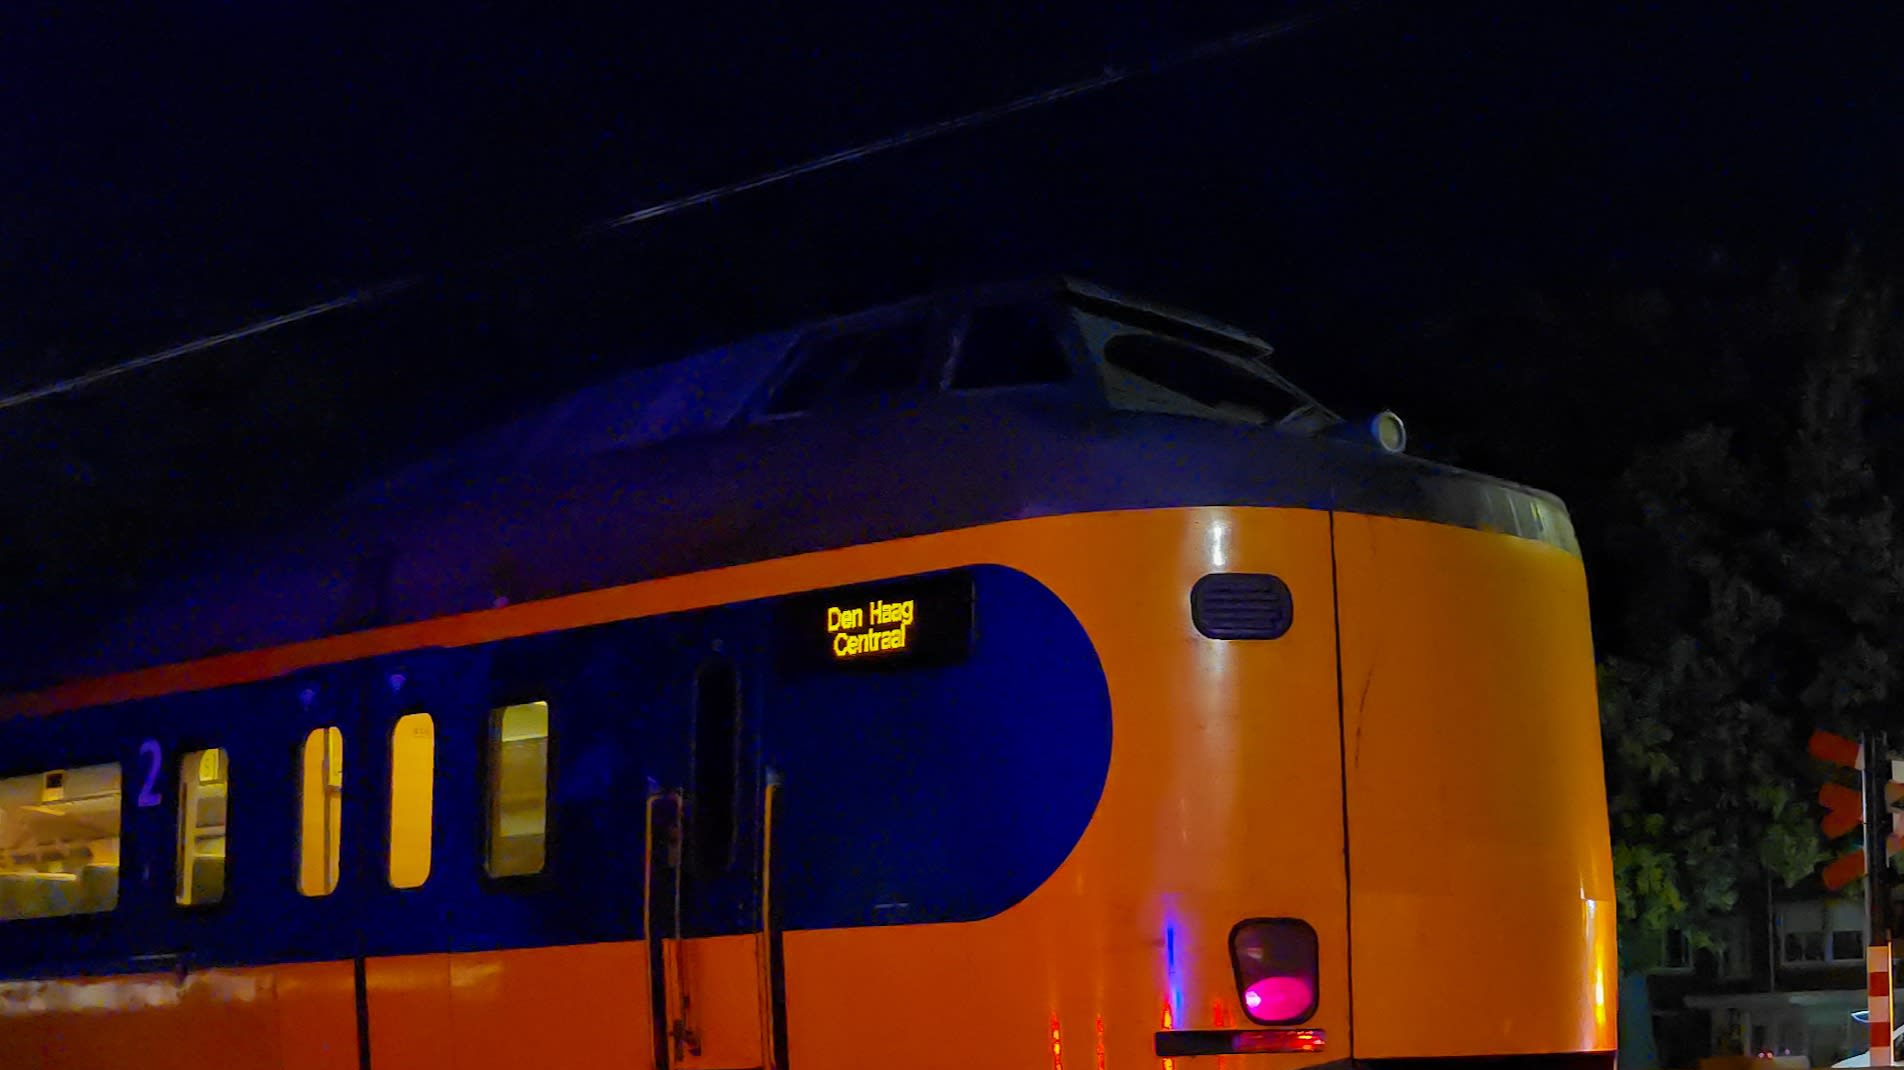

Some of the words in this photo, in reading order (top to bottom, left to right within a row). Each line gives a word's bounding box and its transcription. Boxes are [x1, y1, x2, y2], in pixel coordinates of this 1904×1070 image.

[828, 607, 863, 632] Den
[870, 600, 914, 626] Haag
[834, 624, 906, 656] Centraal
[138, 739, 162, 807] 2
